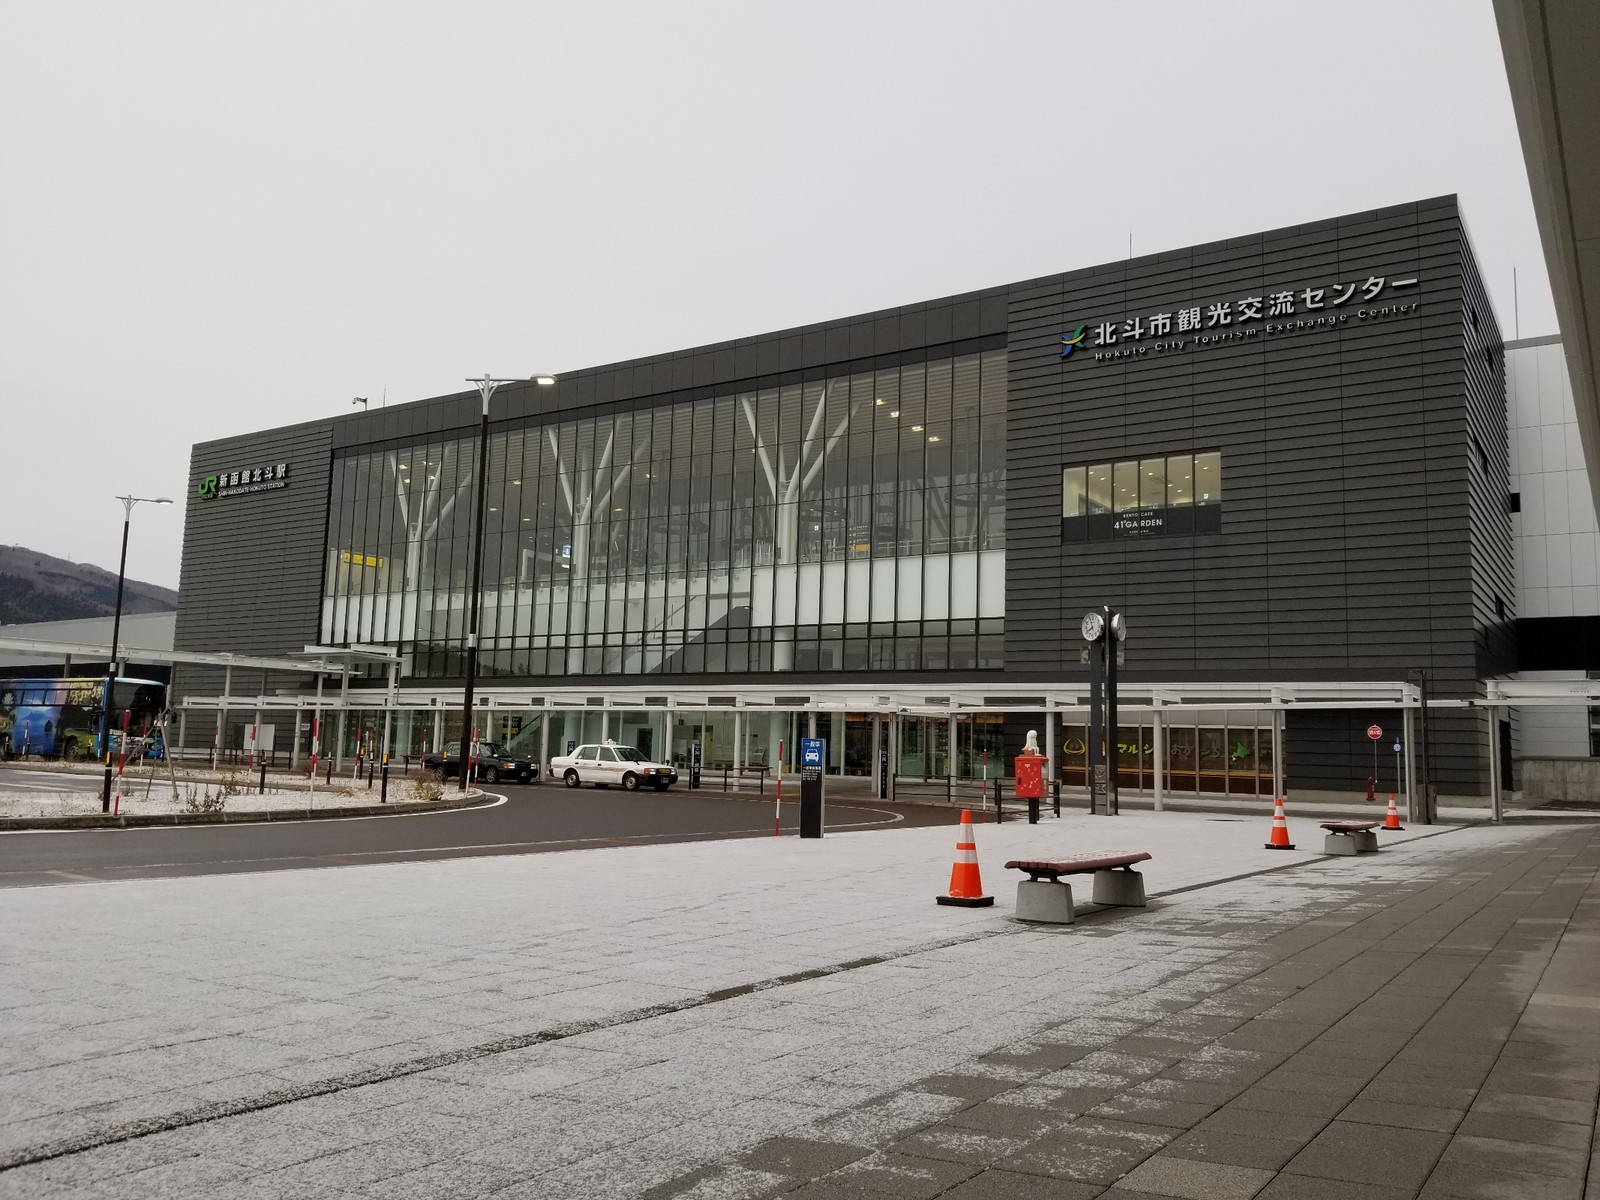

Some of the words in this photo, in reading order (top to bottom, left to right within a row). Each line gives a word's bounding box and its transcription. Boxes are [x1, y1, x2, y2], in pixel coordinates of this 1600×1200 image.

[1094, 276, 1418, 345] 北斗市観光交流センター
[1095, 345, 1146, 361] Hokuto
[1154, 339, 1185, 352] City
[1193, 328, 1257, 345] Tourism
[1266, 313, 1348, 333] Exchange
[1358, 302, 1418, 318] Center
[198, 475, 217, 494] JR
[219, 463, 286, 487] 新函館北斗駅
[1117, 743, 1154, 754] マルシ
